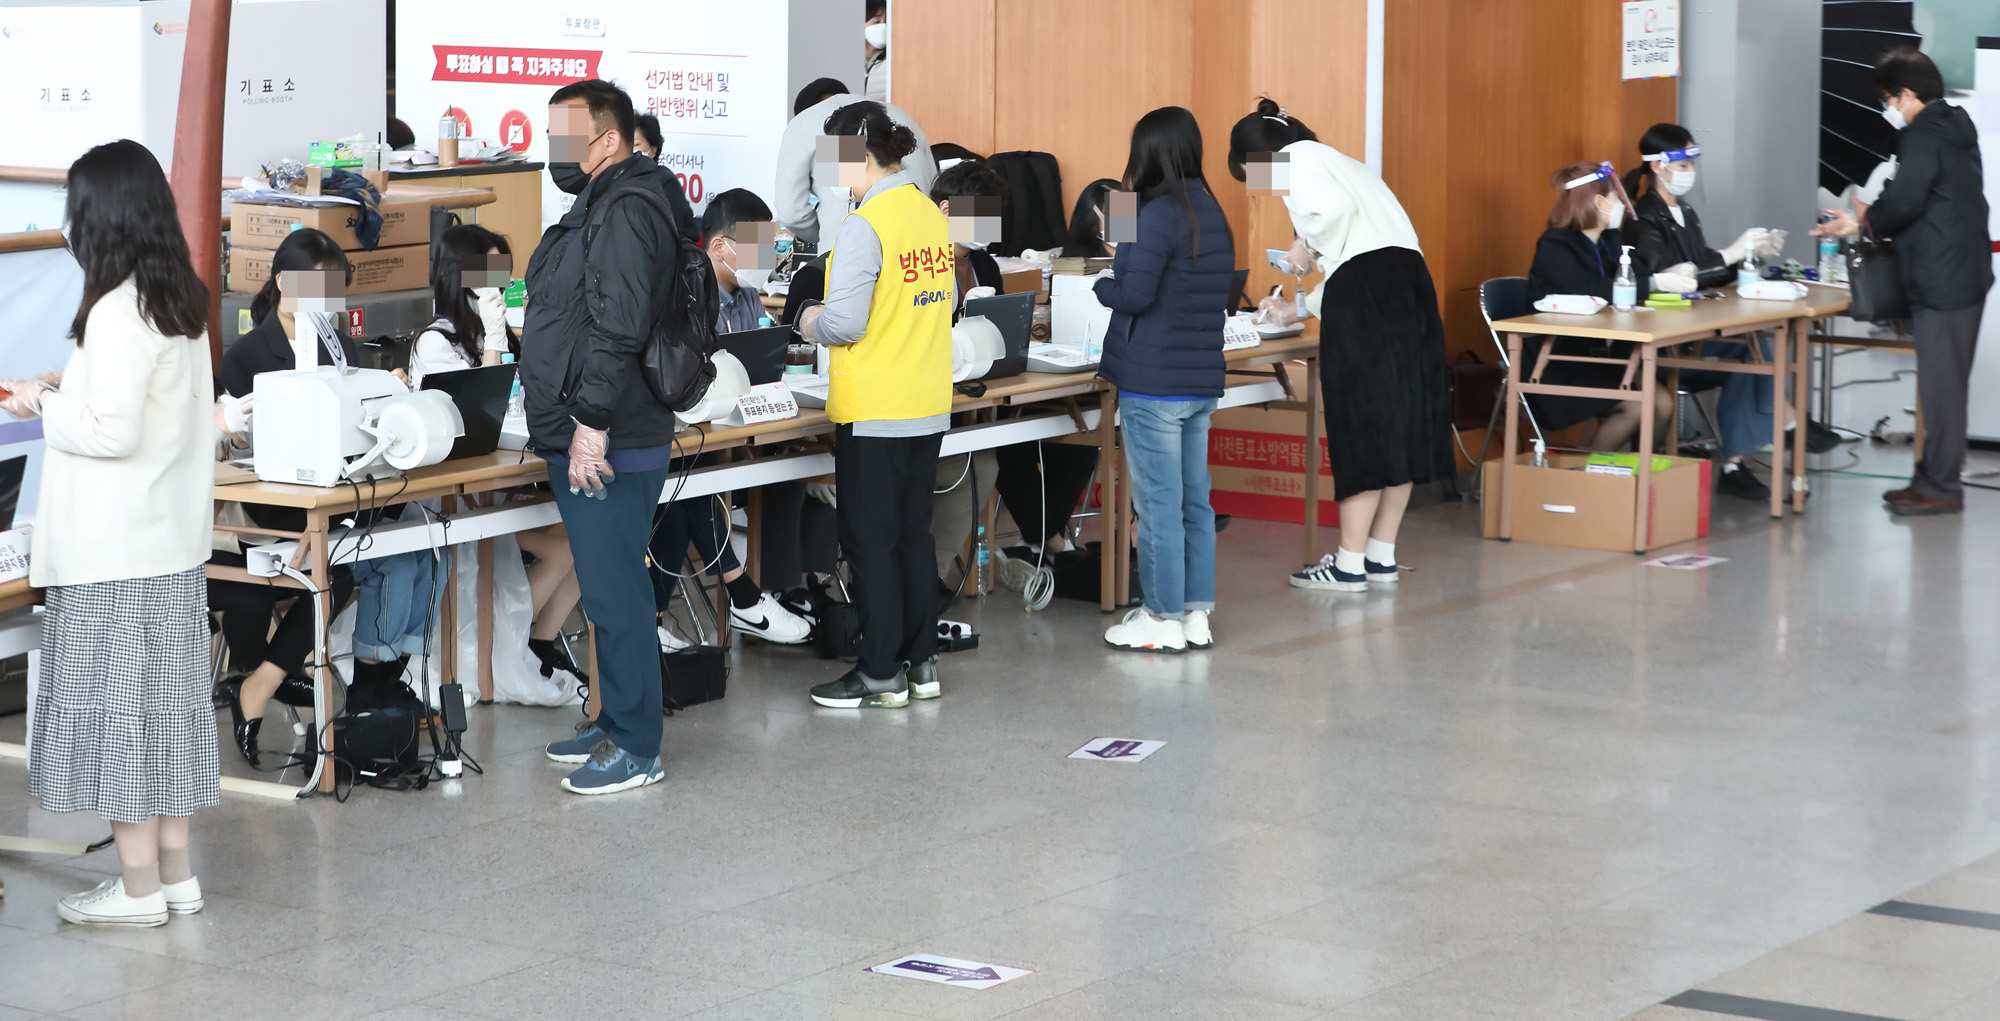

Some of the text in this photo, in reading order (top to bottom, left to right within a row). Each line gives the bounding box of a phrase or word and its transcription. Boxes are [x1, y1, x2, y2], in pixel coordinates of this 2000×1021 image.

[446, 54, 588, 78] 투표하실 때 꼭 지켜주세요
[645, 69, 730, 92] 선거법 안내 및
[242, 95, 293, 105] POLLING BOOTH
[647, 96, 728, 119] 위반행위 신고
[744, 400, 795, 417] 투표용지 등 받는 곳
